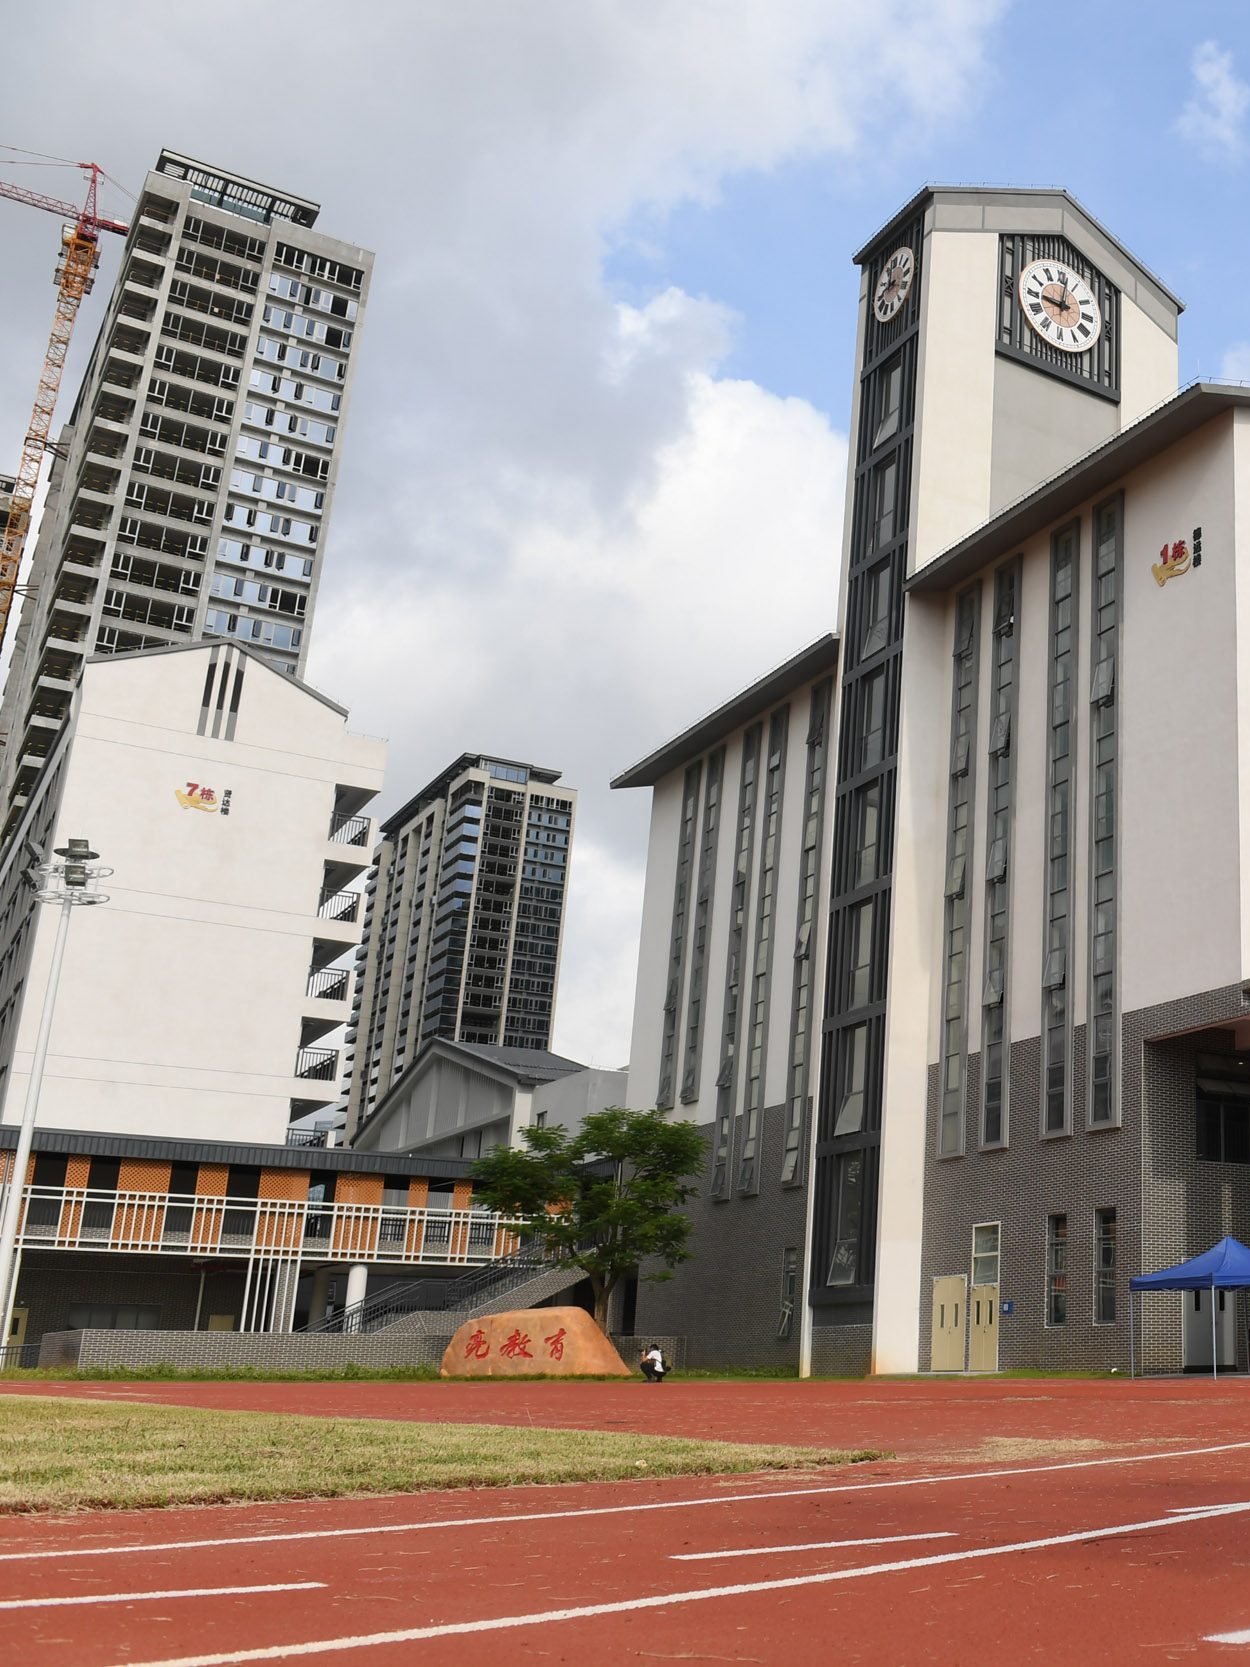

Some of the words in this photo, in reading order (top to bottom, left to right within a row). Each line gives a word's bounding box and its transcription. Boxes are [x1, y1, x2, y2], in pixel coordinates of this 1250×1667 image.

[1031, 274, 1044, 287] X
[1071, 283, 1079, 292] I
[1081, 312, 1093, 324] III
[1070, 329, 1079, 343] V
[1160, 540, 1186, 565] 1栋
[186, 782, 214, 801] 7栋
[464, 1328, 567, 1361] 亮教育
